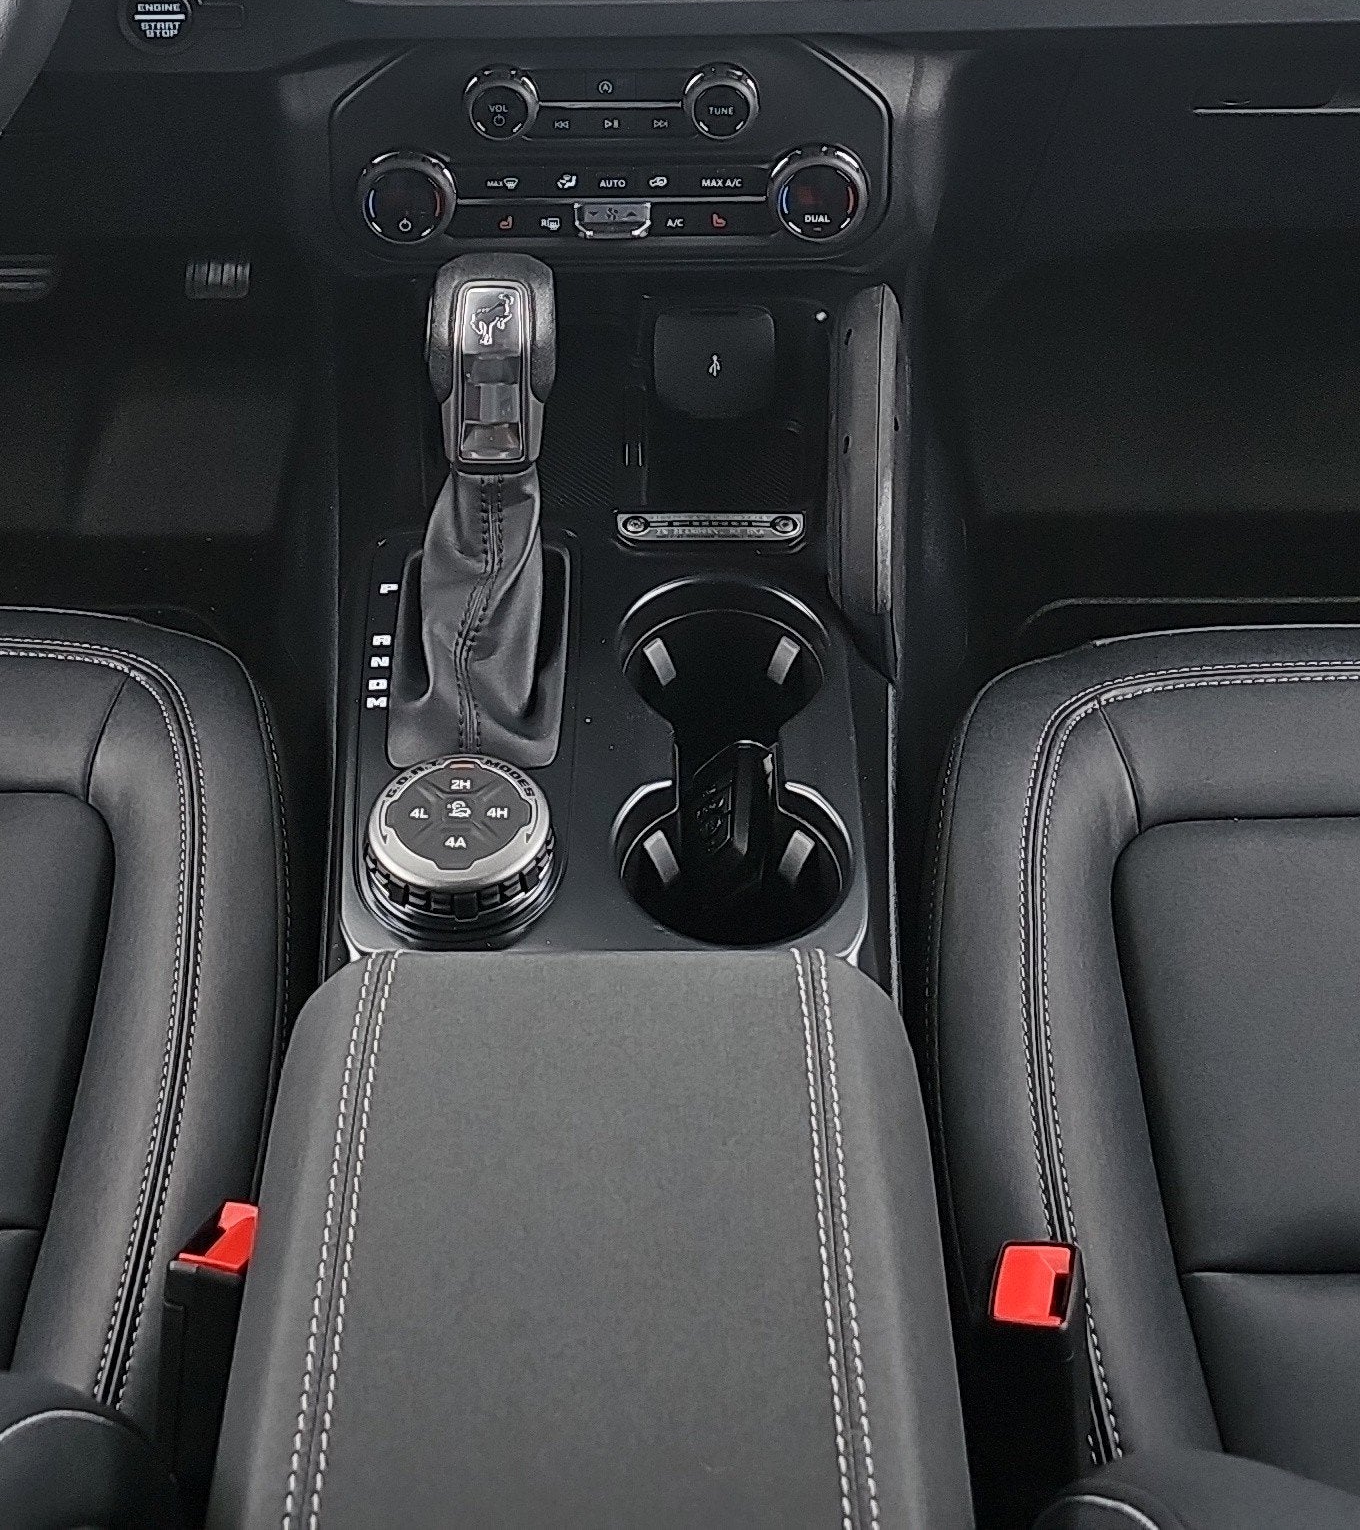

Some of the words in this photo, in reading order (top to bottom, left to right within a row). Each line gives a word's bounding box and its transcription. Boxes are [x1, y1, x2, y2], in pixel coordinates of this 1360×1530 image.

[137, 3, 180, 12] ENGINE
[141, 22, 180, 30] START
[146, 30, 178, 38] STOP
[489, 105, 508, 113] VOL
[709, 106, 734, 115] TUNE
[599, 179, 626, 188] AUTO
[702, 178, 724, 187] MAX
[725, 178, 743, 187] A/C
[667, 219, 684, 228] A/C
[804, 214, 830, 223] DUAL
[380, 583, 398, 594] P
[371, 656, 389, 667] N
[368, 678, 388, 690] D
[366, 696, 388, 708] M
[485, 759, 535, 798] MODES
[450, 779, 471, 790] 2H
[409, 808, 429, 819] 4L
[486, 807, 508, 818] 4H
[444, 836, 467, 848] 4A
